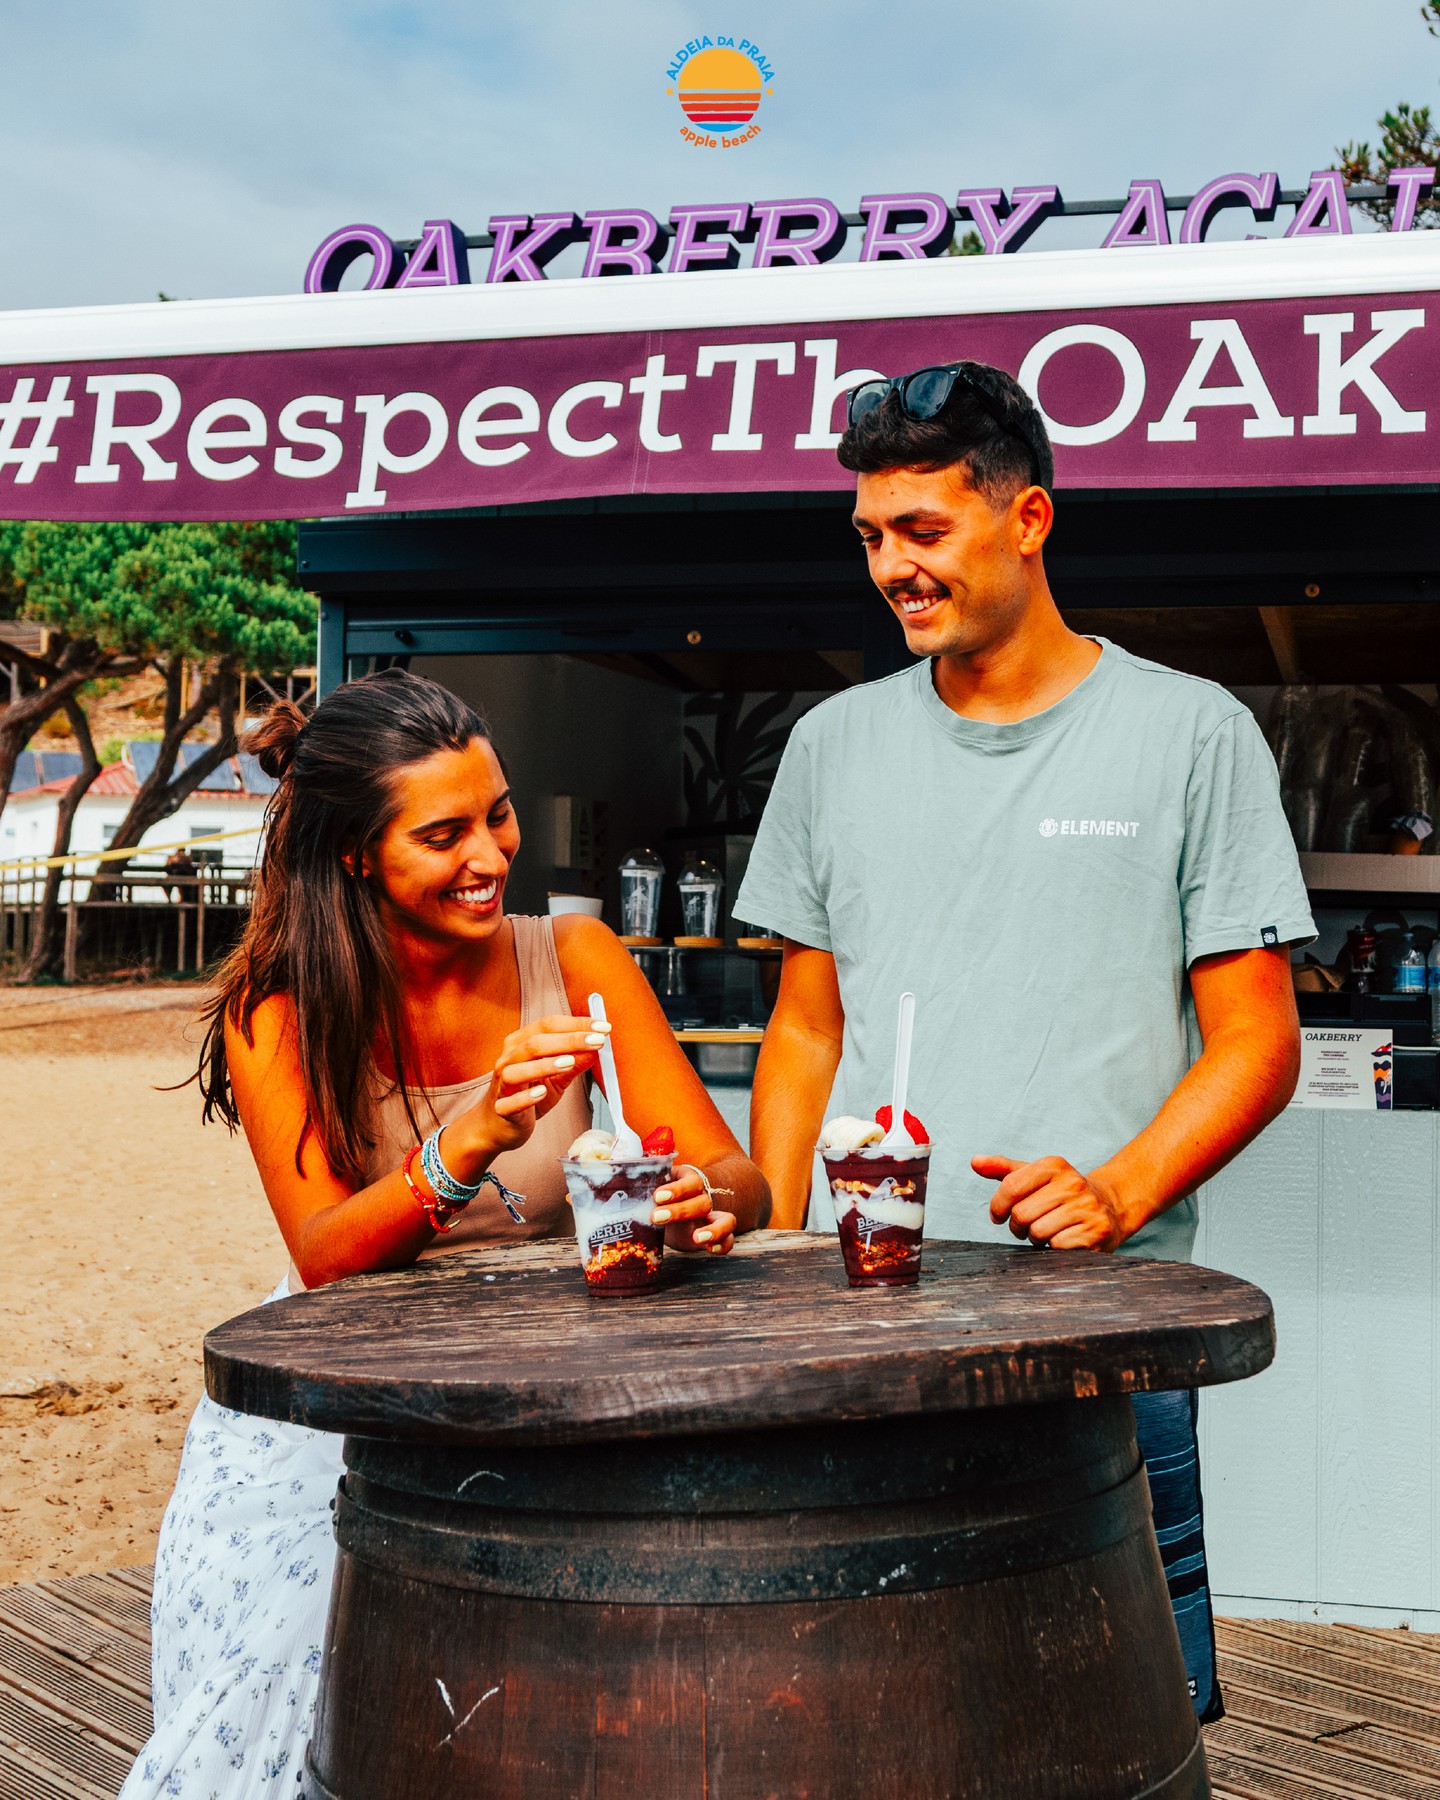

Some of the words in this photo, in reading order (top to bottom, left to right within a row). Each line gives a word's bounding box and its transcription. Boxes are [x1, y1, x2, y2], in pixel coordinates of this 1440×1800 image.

[304, 184, 1060, 294] OAKBERRY
[1060, 820, 1140, 838] ELEMENT
[1305, 1032, 1363, 1042] OAKBERRY
[590, 1220, 633, 1241] BERRY
